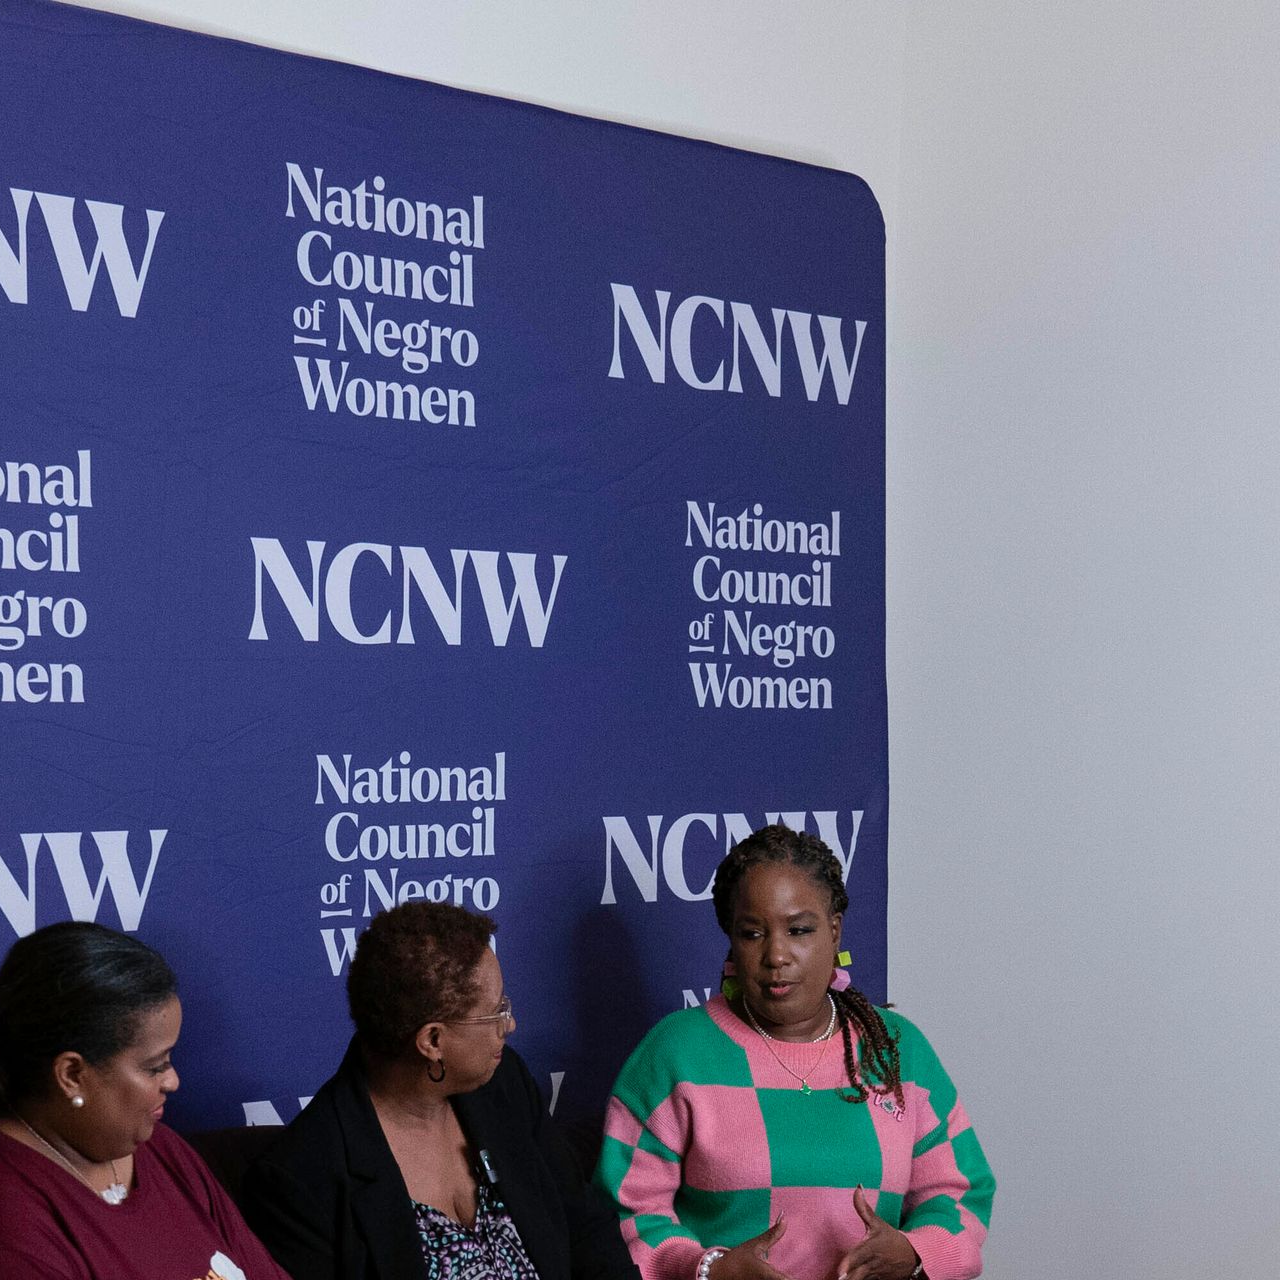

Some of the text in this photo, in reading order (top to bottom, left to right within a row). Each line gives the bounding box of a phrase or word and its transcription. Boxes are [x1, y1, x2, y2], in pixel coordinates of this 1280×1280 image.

[284, 162, 485, 250] National
[295, 229, 477, 308] Council
[292, 297, 480, 374] of Negro
[607, 282, 867, 406] NCNW
[292, 355, 477, 428] Women
[684, 499, 841, 557] National
[248, 536, 569, 646] NCNW
[691, 554, 832, 608] Council
[687, 610, 836, 669] of Negro
[687, 661, 833, 710] Women
[314, 750, 507, 806] National
[323, 805, 496, 864] Council
[320, 867, 500, 919] of Negro
